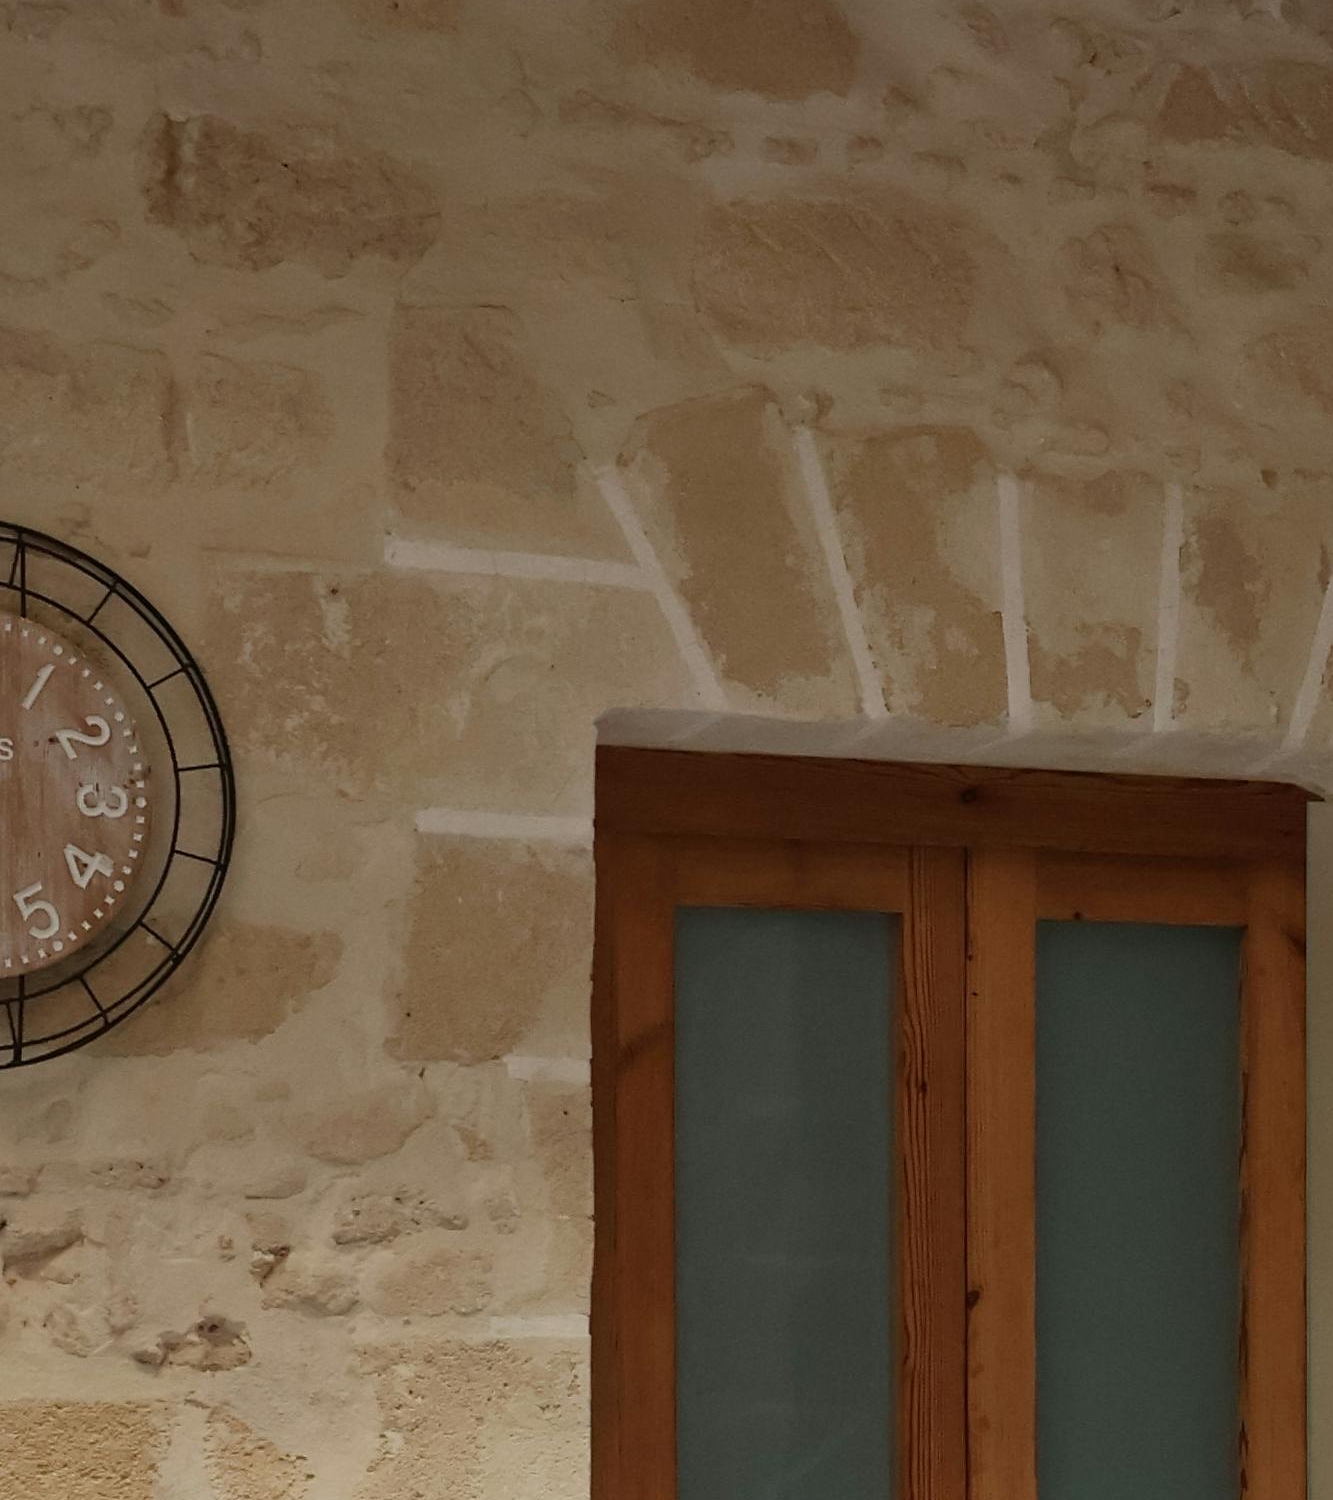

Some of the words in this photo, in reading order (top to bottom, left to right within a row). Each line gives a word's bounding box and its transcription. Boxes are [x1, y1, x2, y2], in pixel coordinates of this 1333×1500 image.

[22, 663, 55, 710] 1
[55, 715, 110, 760] 2
[76, 785, 128, 818] 3
[64, 843, 114, 889] 4
[13, 881, 60, 939] 5
